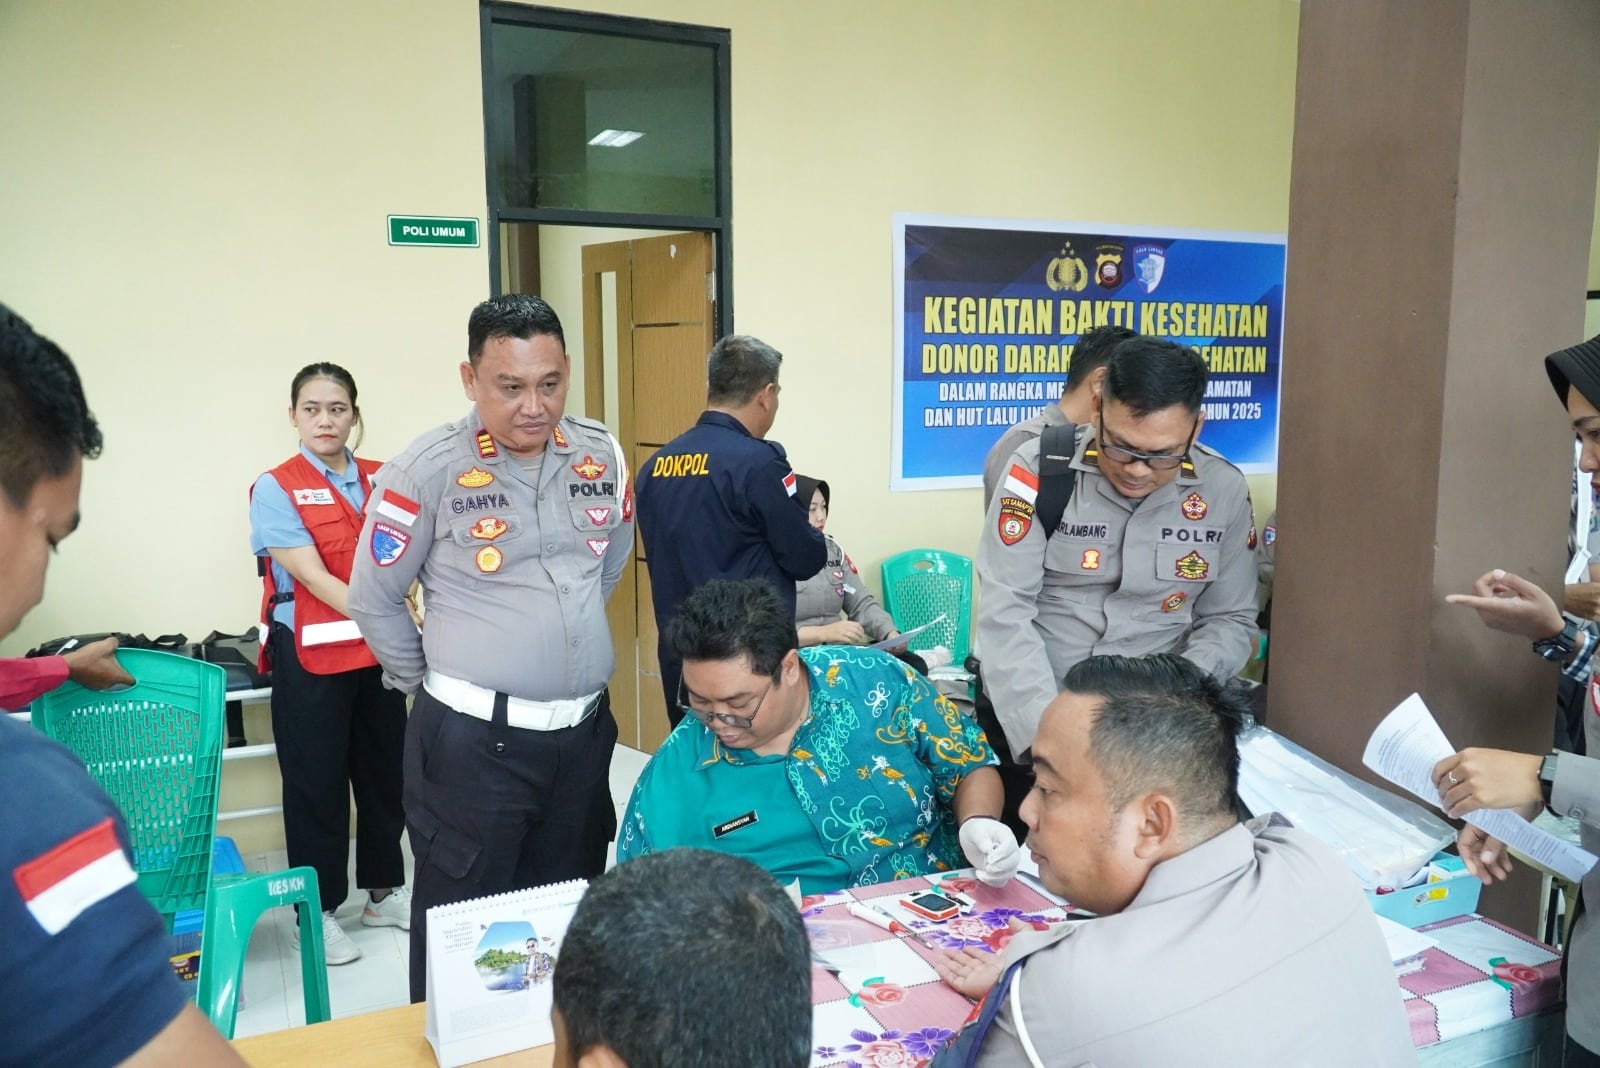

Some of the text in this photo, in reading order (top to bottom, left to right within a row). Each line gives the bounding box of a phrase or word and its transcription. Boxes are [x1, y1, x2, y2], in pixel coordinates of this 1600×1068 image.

[402, 226, 465, 237] POLI UMUM
[924, 296, 1268, 337] KEGIATAN BAKTI KESEHATAN
[922, 343, 998, 374] DONOR
[939, 382, 986, 401] DALAM
[990, 382, 1043, 401] RANGKA
[1203, 380, 1252, 398] AMATAN
[924, 408, 953, 427] DAN
[956, 407, 984, 426] HUT
[986, 407, 1018, 426] LALU
[1200, 403, 1230, 420] AHUN
[1232, 402, 1262, 419] 2025
[652, 453, 710, 477] DOKPOL
[569, 482, 614, 498] POLRI
[451, 493, 511, 514] CAHYA
[1161, 527, 1222, 543] POLRI
